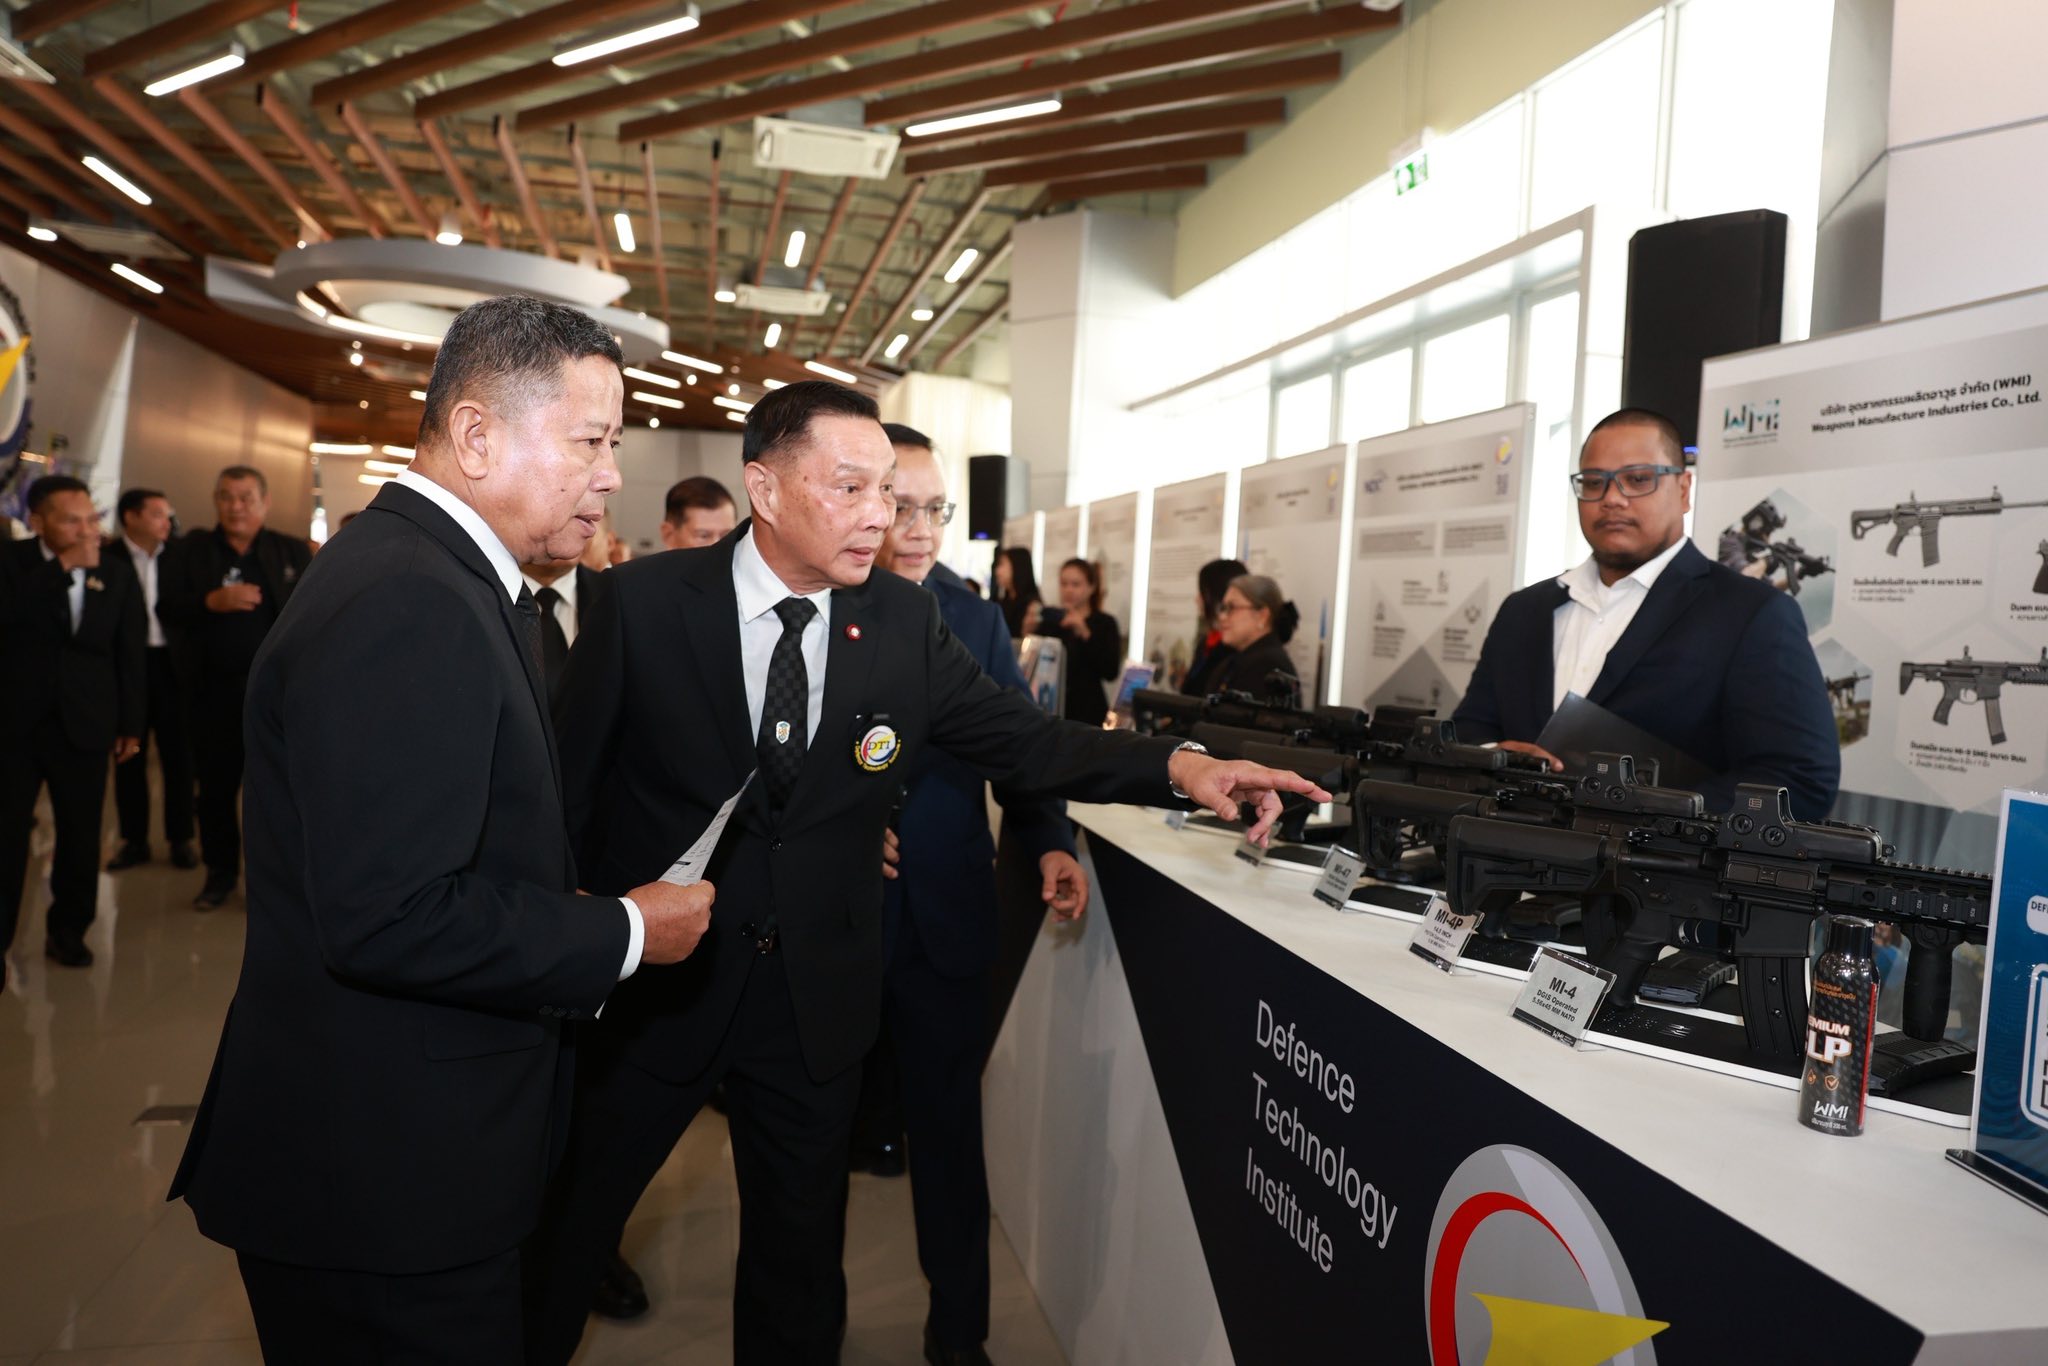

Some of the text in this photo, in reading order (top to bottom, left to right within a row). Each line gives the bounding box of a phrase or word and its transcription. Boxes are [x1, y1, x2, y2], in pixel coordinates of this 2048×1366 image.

[1960, 382, 1990, 397] จำกัด
[1993, 375, 2031, 391] (WMI)
[1812, 391, 2042, 433] Weapons Manufacture Industries Co., Ltd.
[868, 740, 890, 751] DTI
[1434, 908, 1464, 930] MI-4P
[1548, 976, 1578, 1000] MI-4
[1536, 989, 1579, 1014] DGIS Operated
[1551, 1005, 1561, 1016] MM
[1560, 1010, 1576, 1022] NATO
[1256, 999, 1355, 1114] Defence
[1805, 1029, 1852, 1064] LP
[1813, 1100, 1849, 1119] WMI
[1252, 1071, 1398, 1249] Technology
[1246, 1147, 1333, 1273] Institute
